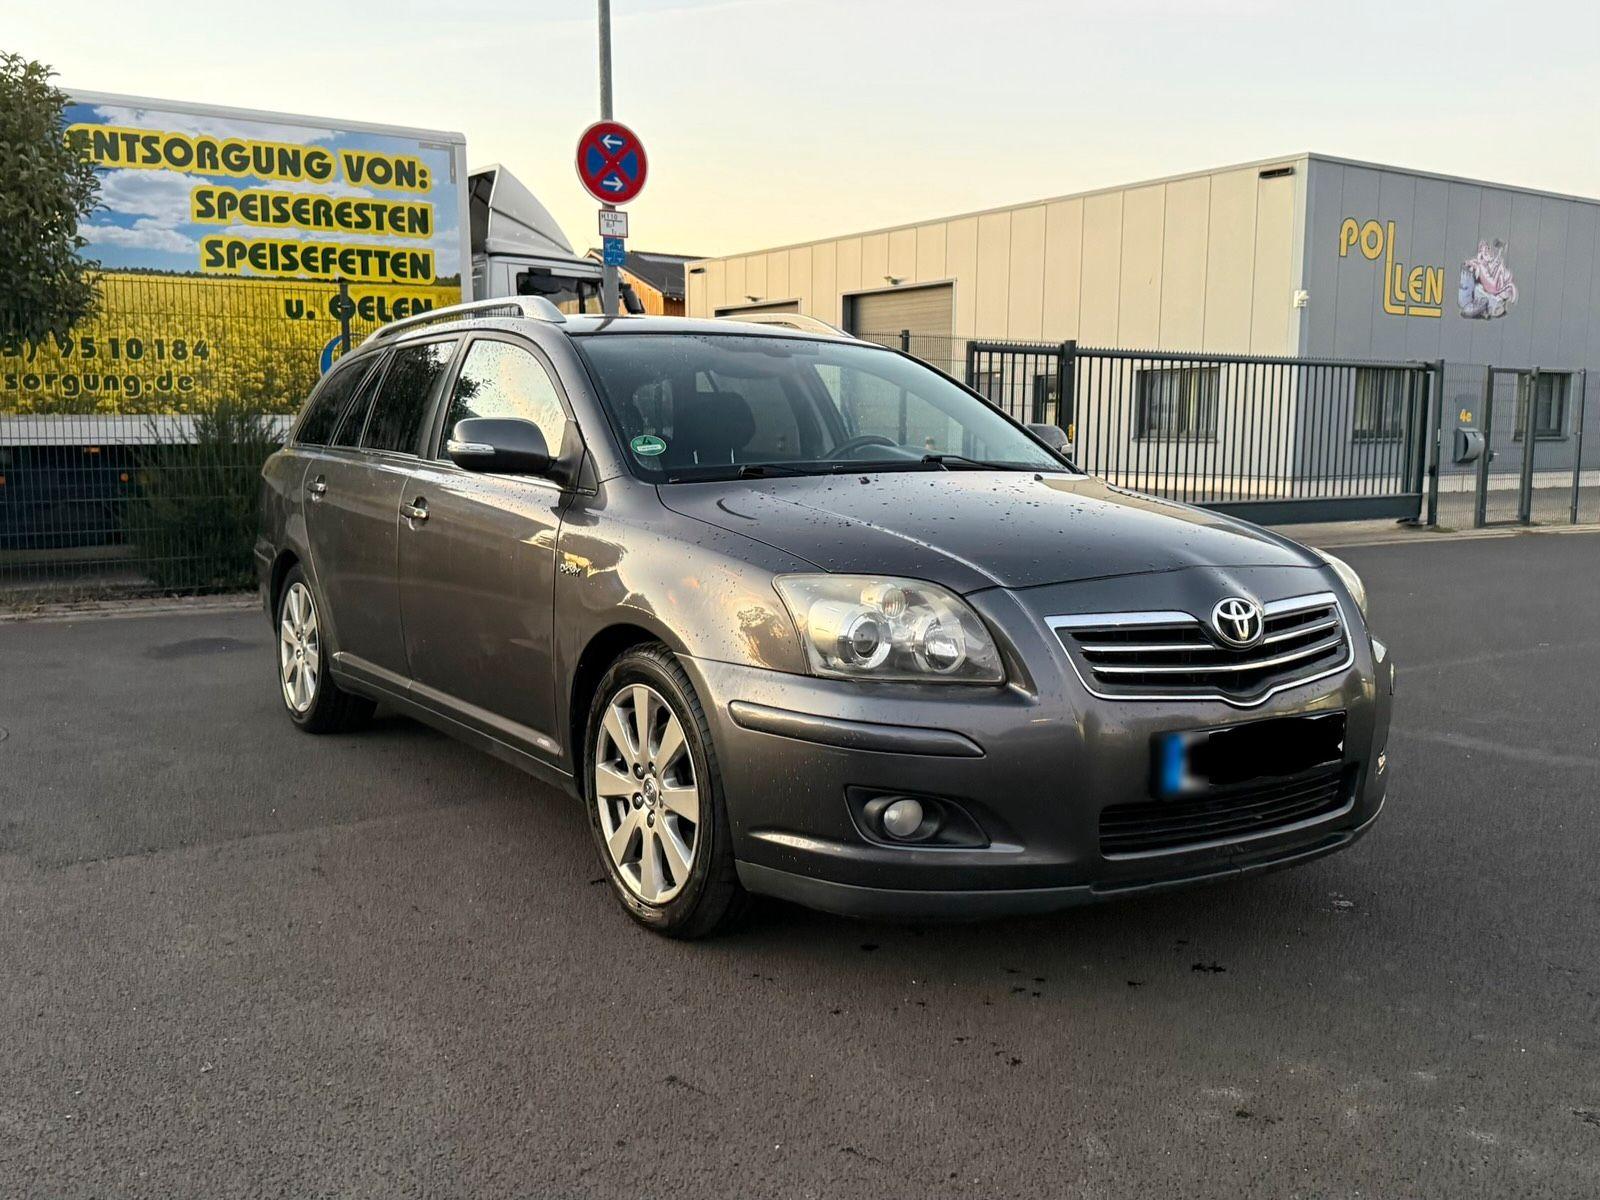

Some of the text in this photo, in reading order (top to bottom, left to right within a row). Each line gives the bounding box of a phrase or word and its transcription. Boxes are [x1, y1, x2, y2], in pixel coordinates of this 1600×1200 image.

[73, 129, 429, 189] ENTSORGUNG VON:
[195, 190, 430, 235] SPEISERESTEN
[205, 240, 432, 280] SPEISEFETTEN
[1339, 217, 1444, 318] POLLEN
[285, 298, 316, 320] u.
[154, 338, 210, 361] 184
[4, 371, 195, 398] sorgung.de
